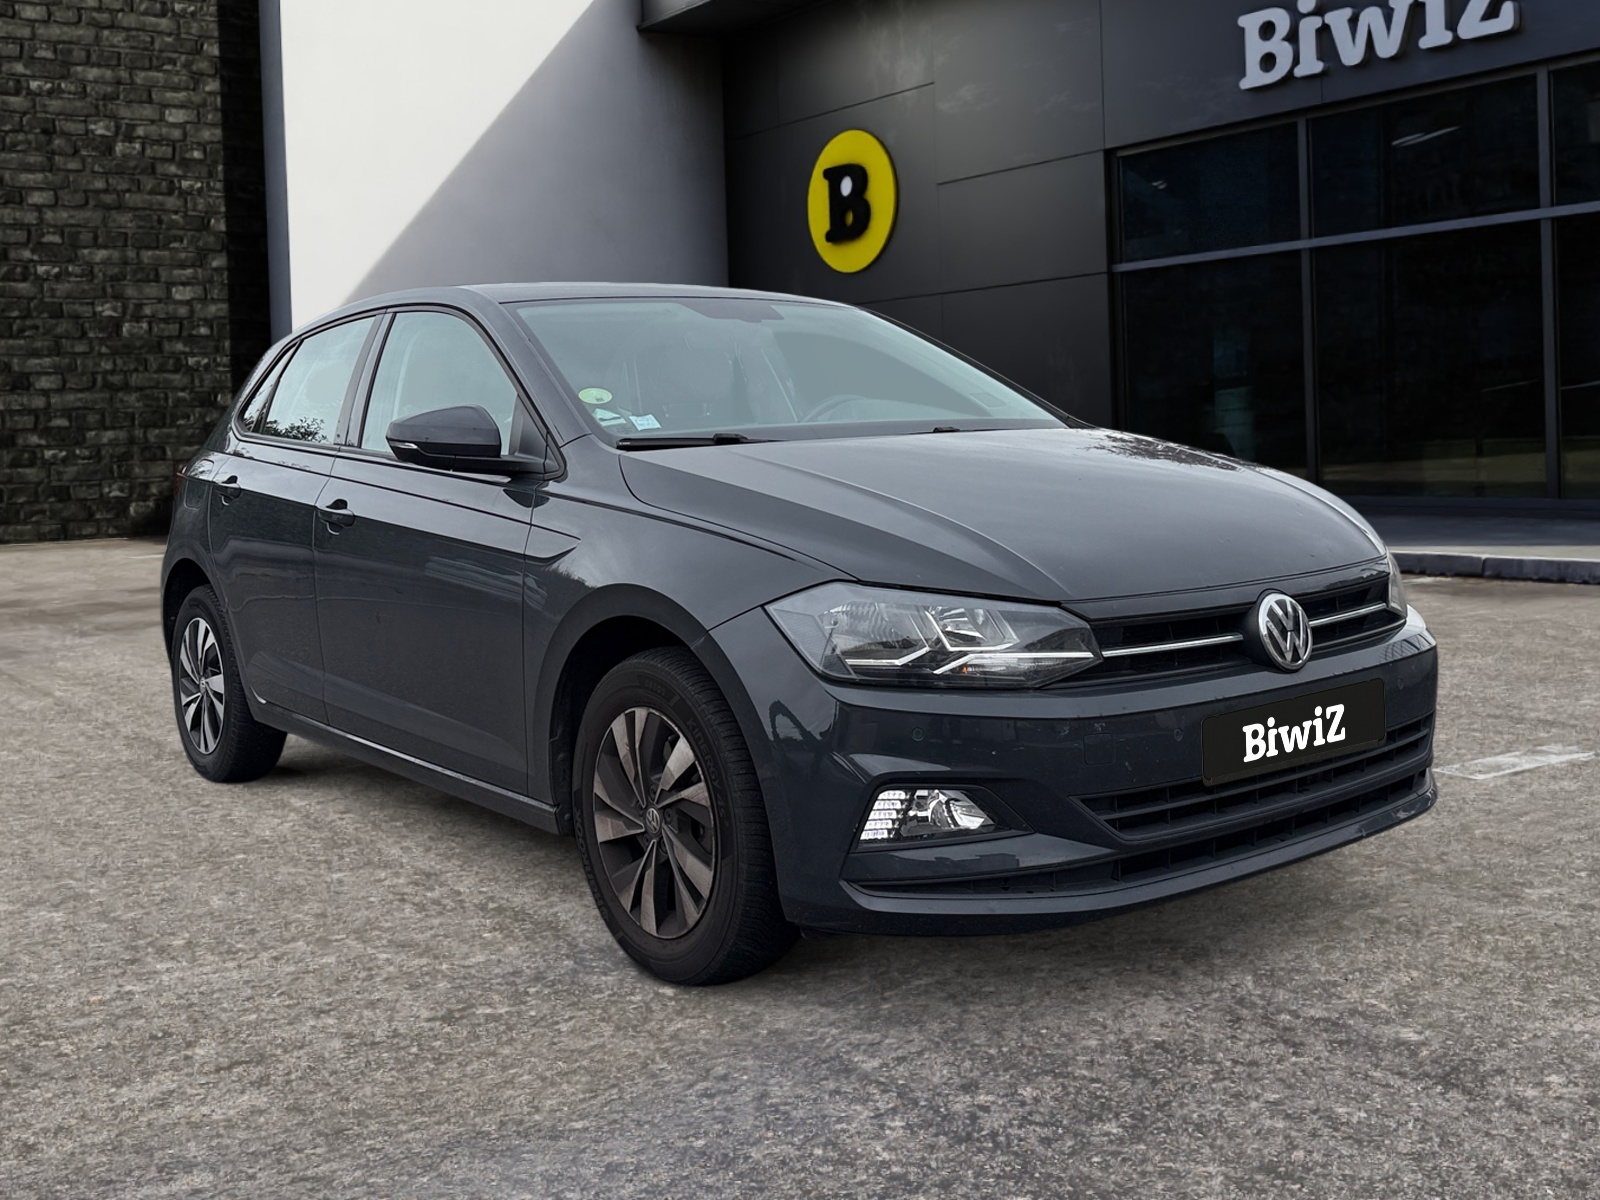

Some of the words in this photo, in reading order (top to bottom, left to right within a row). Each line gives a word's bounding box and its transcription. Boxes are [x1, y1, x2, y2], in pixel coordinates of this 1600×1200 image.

[822, 163, 871, 243] B
[1260, 594, 1312, 668] VW
[1242, 703, 1346, 763] BiwiZ
